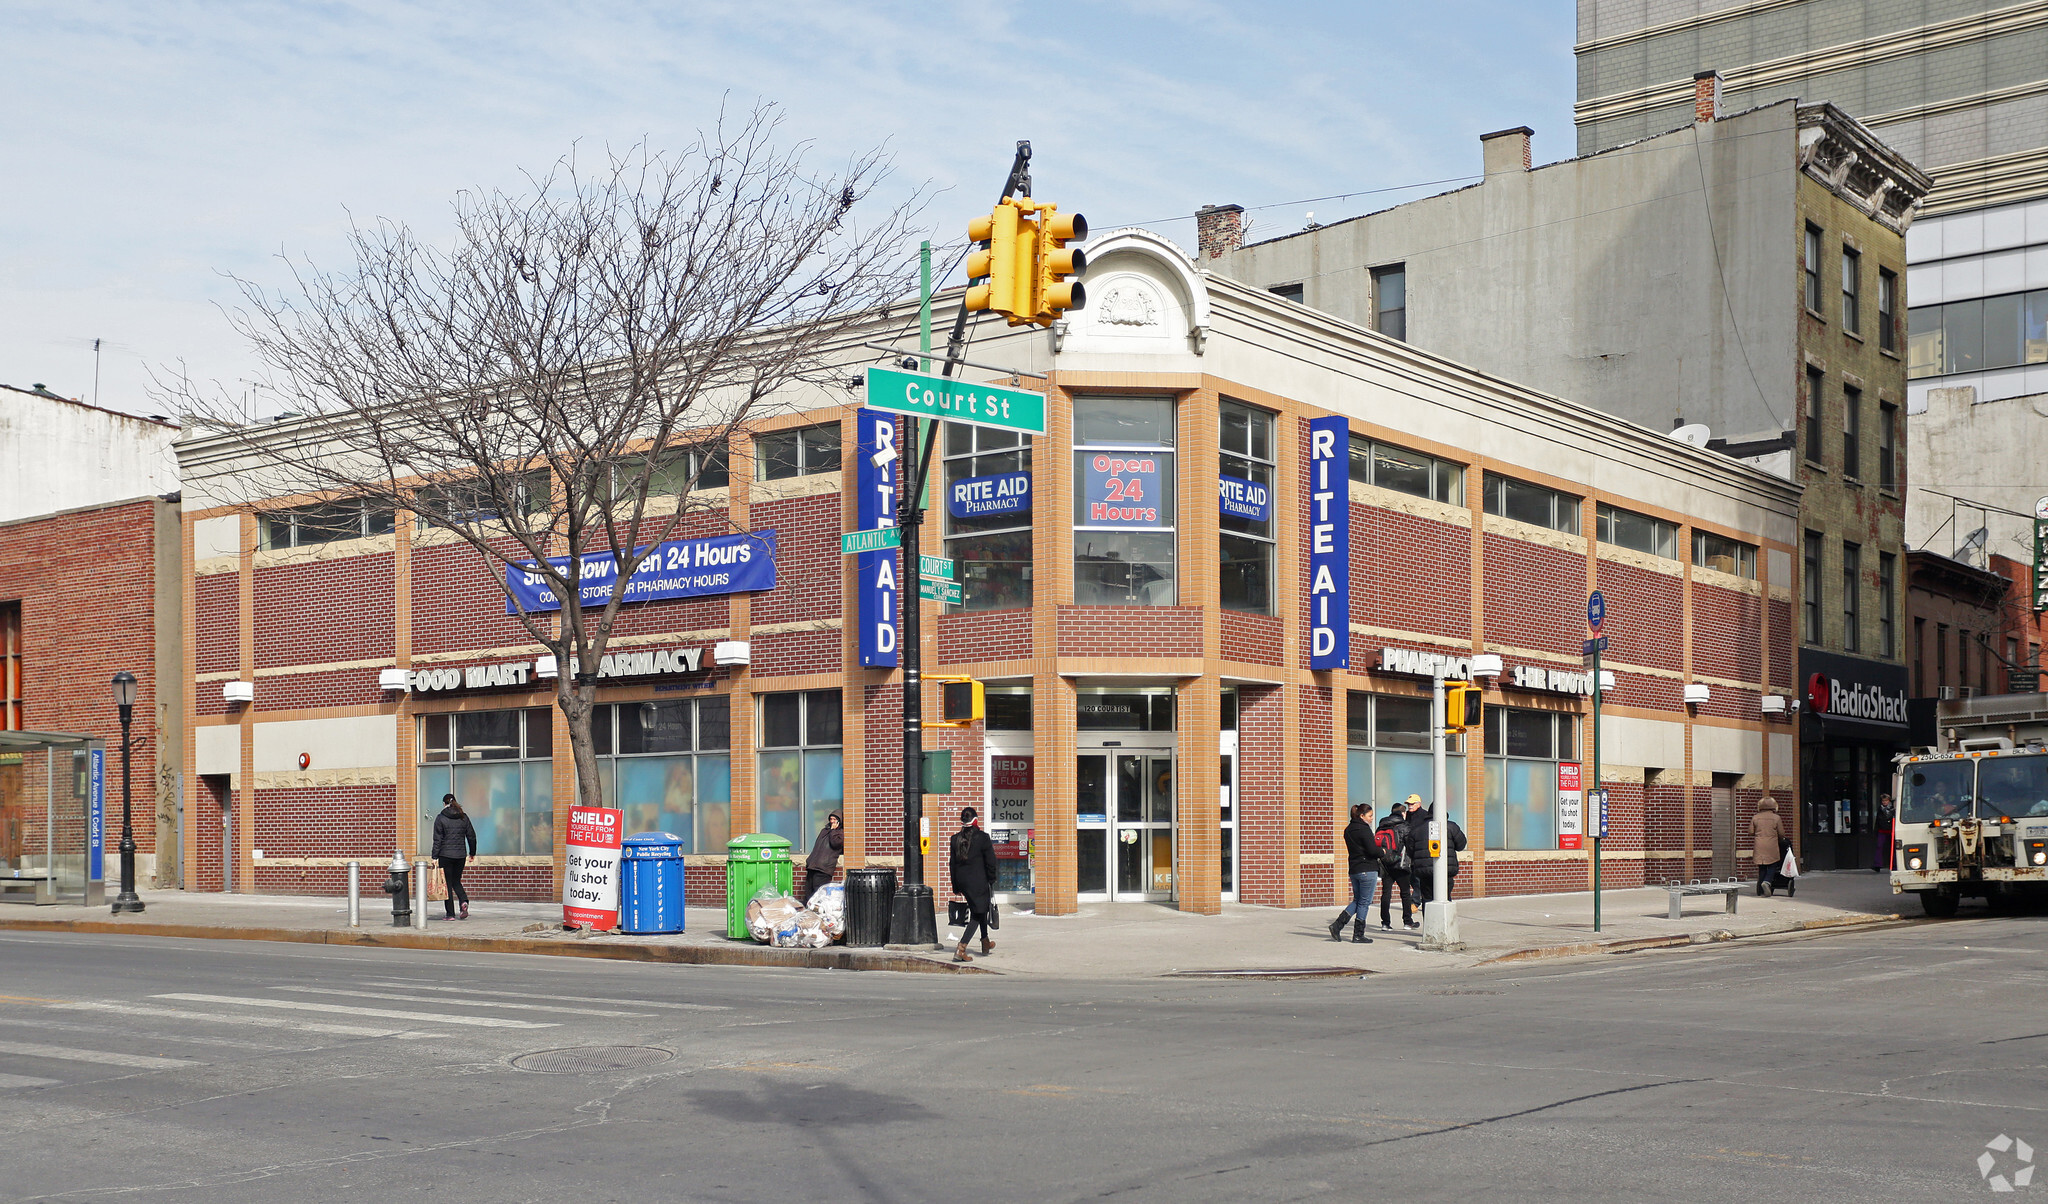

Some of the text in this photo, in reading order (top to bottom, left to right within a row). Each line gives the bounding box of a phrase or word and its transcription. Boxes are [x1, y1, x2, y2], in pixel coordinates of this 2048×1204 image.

[905, 382, 1010, 419] Court St
[1093, 454, 1155, 476] Open
[955, 476, 1029, 503] RITE AID
[1104, 477, 1143, 501] 24
[1246, 486, 1266, 506] AID
[1091, 502, 1156, 521] Hours
[846, 531, 887, 551] ATLANTIC
[1312, 429, 1336, 657] RITE AID
[666, 545, 690, 570] 24
[694, 542, 751, 567] Hours
[920, 557, 952, 576] COURT ST
[582, 584, 614, 599] STORE
[637, 576, 692, 593] PHARMACY
[693, 572, 730, 588] HOURS
[920, 584, 937, 596] MANUEL
[940, 587, 960, 598] SANCHEZ
[876, 559, 896, 653] AID
[569, 648, 705, 680] PARMACY
[404, 661, 531, 693] FOOD MART
[1514, 665, 1595, 696] 1-HR PHOTO
[1831, 678, 1908, 723] RadioShack
[92, 753, 100, 780] Atlantic
[992, 760, 1028, 771] HIELD
[1560, 766, 1579, 775] SHIELD
[92, 781, 100, 808] Avenue
[1002, 799, 1028, 809] your
[1560, 797, 1579, 808] Get your
[571, 811, 615, 827] SHIELD
[1000, 811, 1024, 821] shot
[1568, 809, 1578, 817] shot
[570, 823, 595, 832] YOURSELF
[570, 830, 584, 841] THE
[584, 831, 605, 843] FLU
[92, 839, 100, 848] St
[660, 845, 670, 853] City
[569, 854, 613, 870] Get your
[650, 851, 672, 859] Recycling
[569, 870, 608, 885] flu shot
[569, 887, 601, 902] today.
[572, 911, 604, 920] appointment
